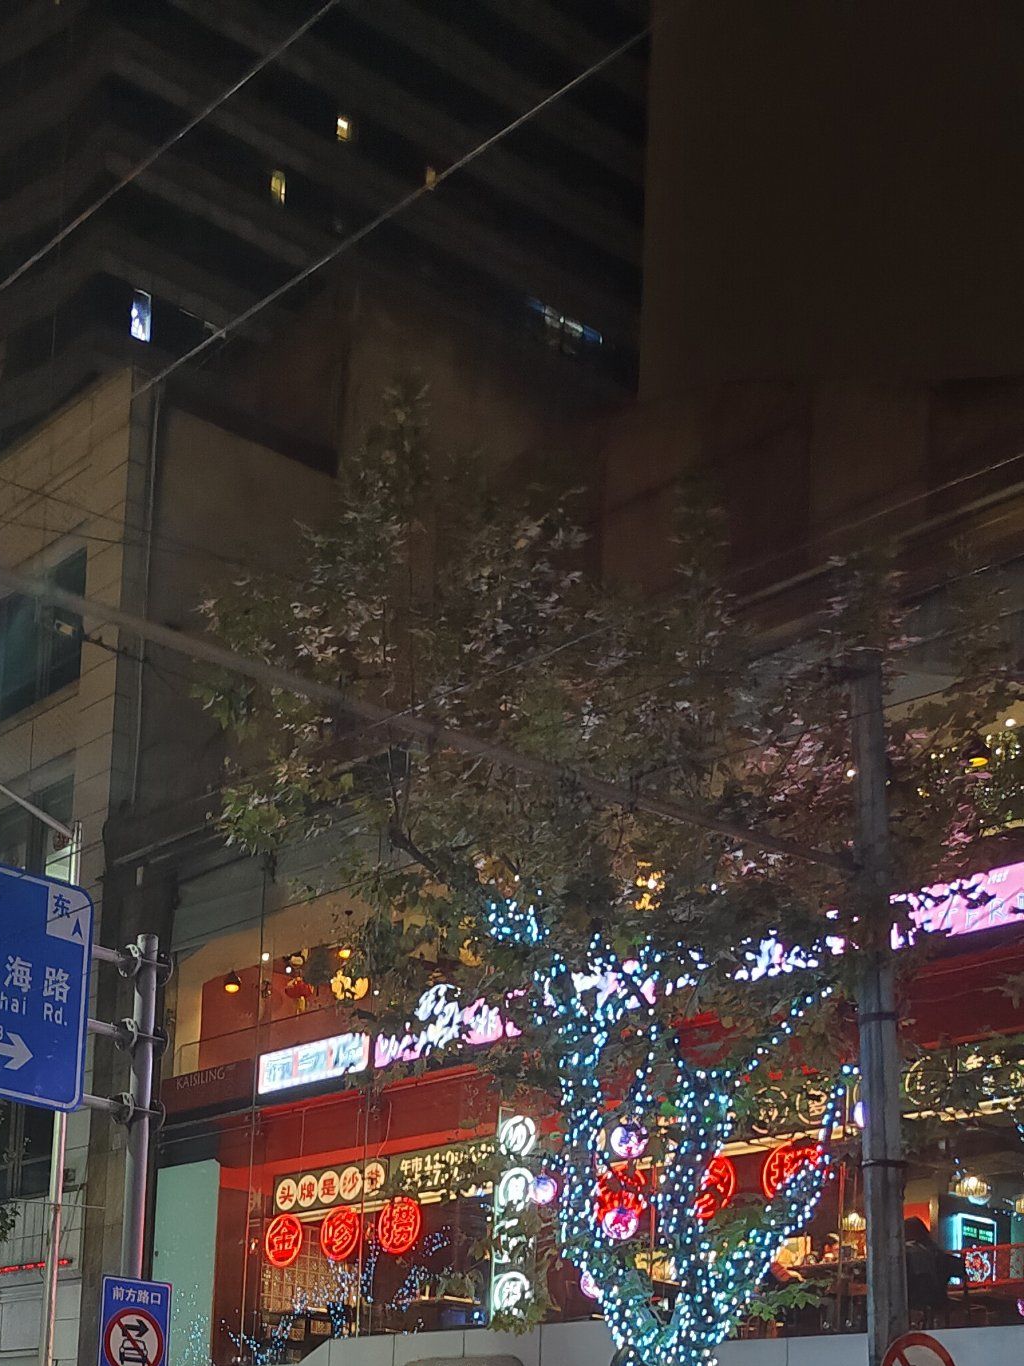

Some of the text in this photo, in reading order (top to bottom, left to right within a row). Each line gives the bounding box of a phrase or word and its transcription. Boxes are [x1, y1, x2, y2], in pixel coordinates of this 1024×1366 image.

[53, 893, 71, 918] 东
[43, 1002, 68, 1026] Rd.
[176, 1066, 226, 1090] KAISILING
[112, 1286, 162, 1306] 前方路口
